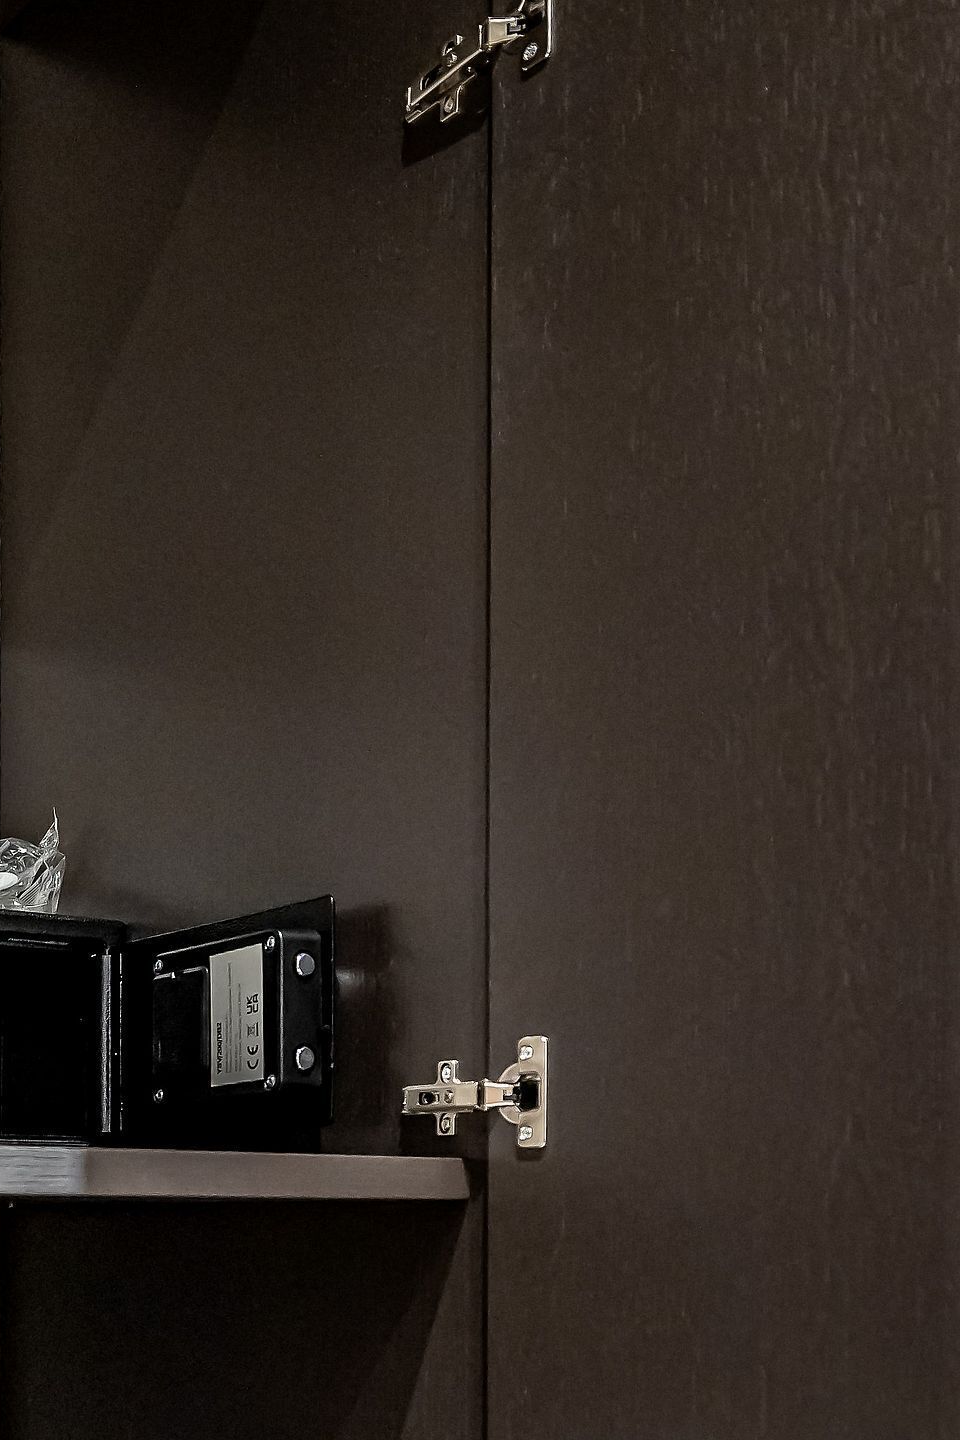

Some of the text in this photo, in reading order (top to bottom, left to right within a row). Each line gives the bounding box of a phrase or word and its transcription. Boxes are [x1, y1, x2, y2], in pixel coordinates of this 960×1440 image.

[246, 995, 253, 1015] UK
[252, 993, 259, 1013] CA
[247, 1044, 259, 1070] CE
